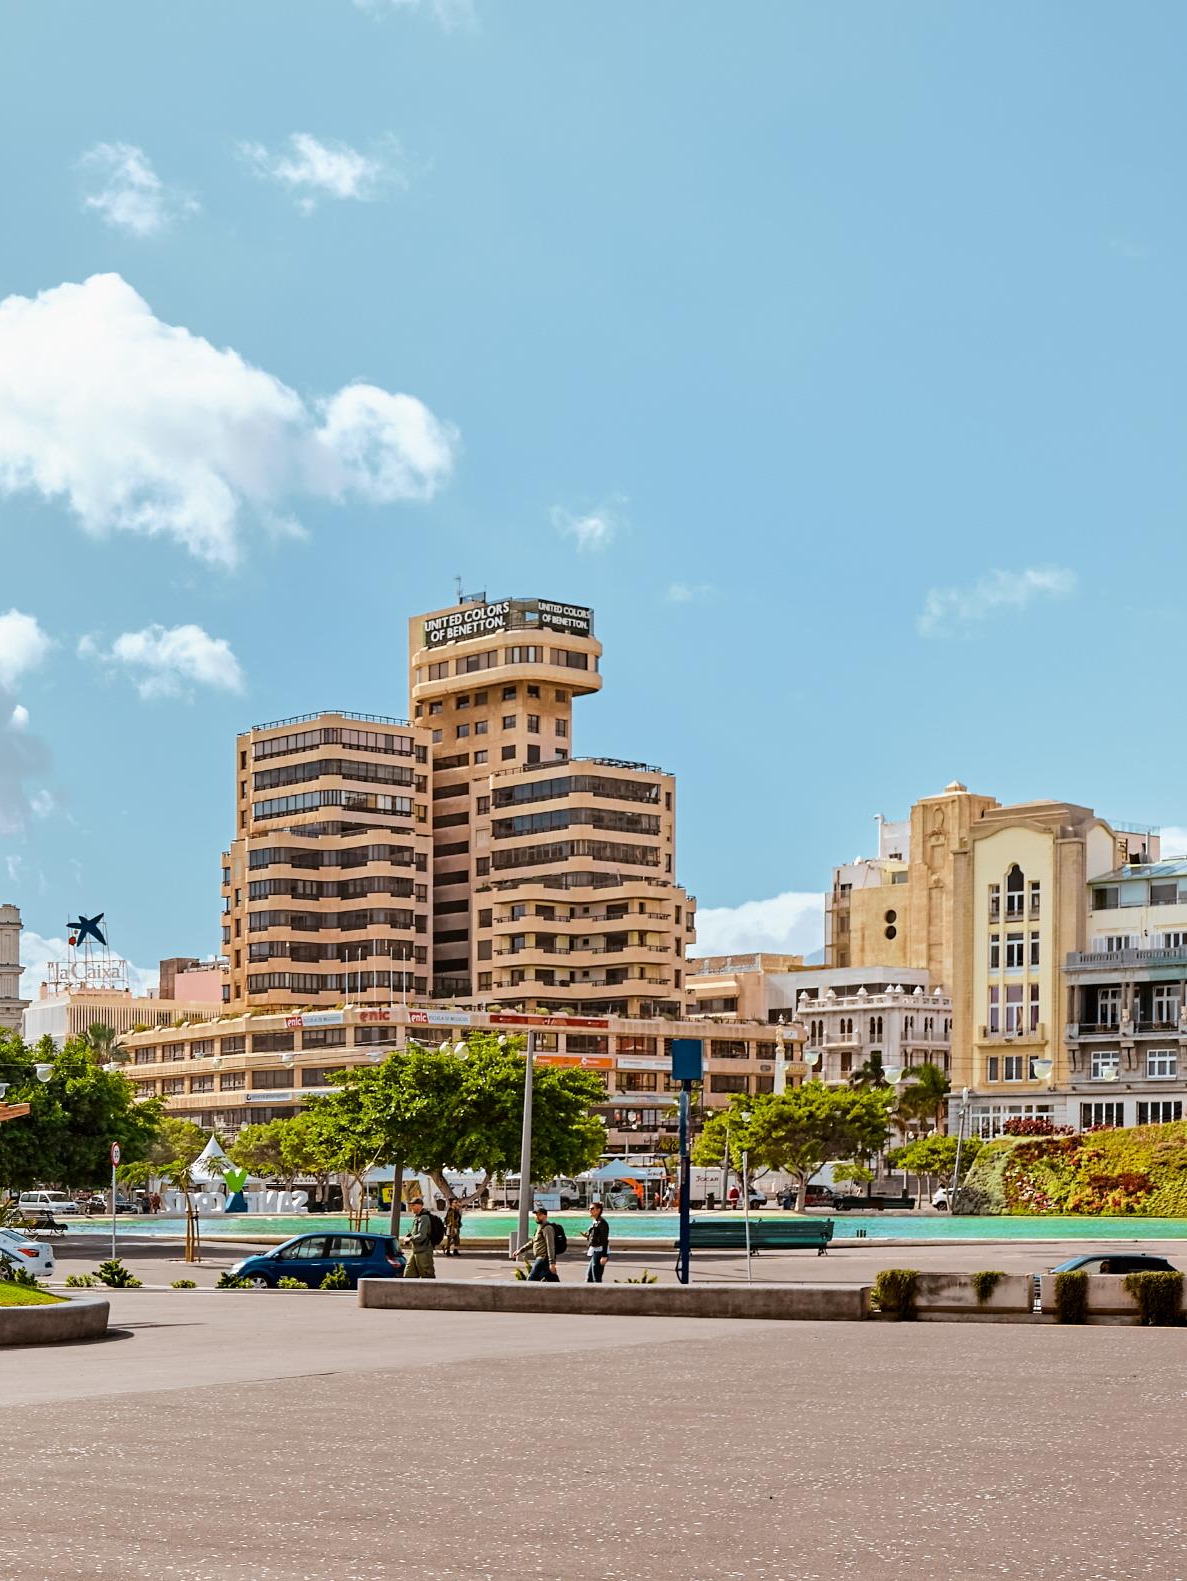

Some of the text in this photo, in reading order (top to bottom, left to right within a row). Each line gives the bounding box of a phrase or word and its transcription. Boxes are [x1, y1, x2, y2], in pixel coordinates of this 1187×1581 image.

[424, 601, 510, 632] UNITED COLORS
[538, 602, 590, 619] UNITED COLORS
[430, 615, 506, 642] OF BENETTON.
[541, 614, 589, 629] OF BENETTON.
[287, 1017, 302, 1027] enic
[359, 1010, 390, 1022] enic
[411, 1013, 427, 1023] enic
